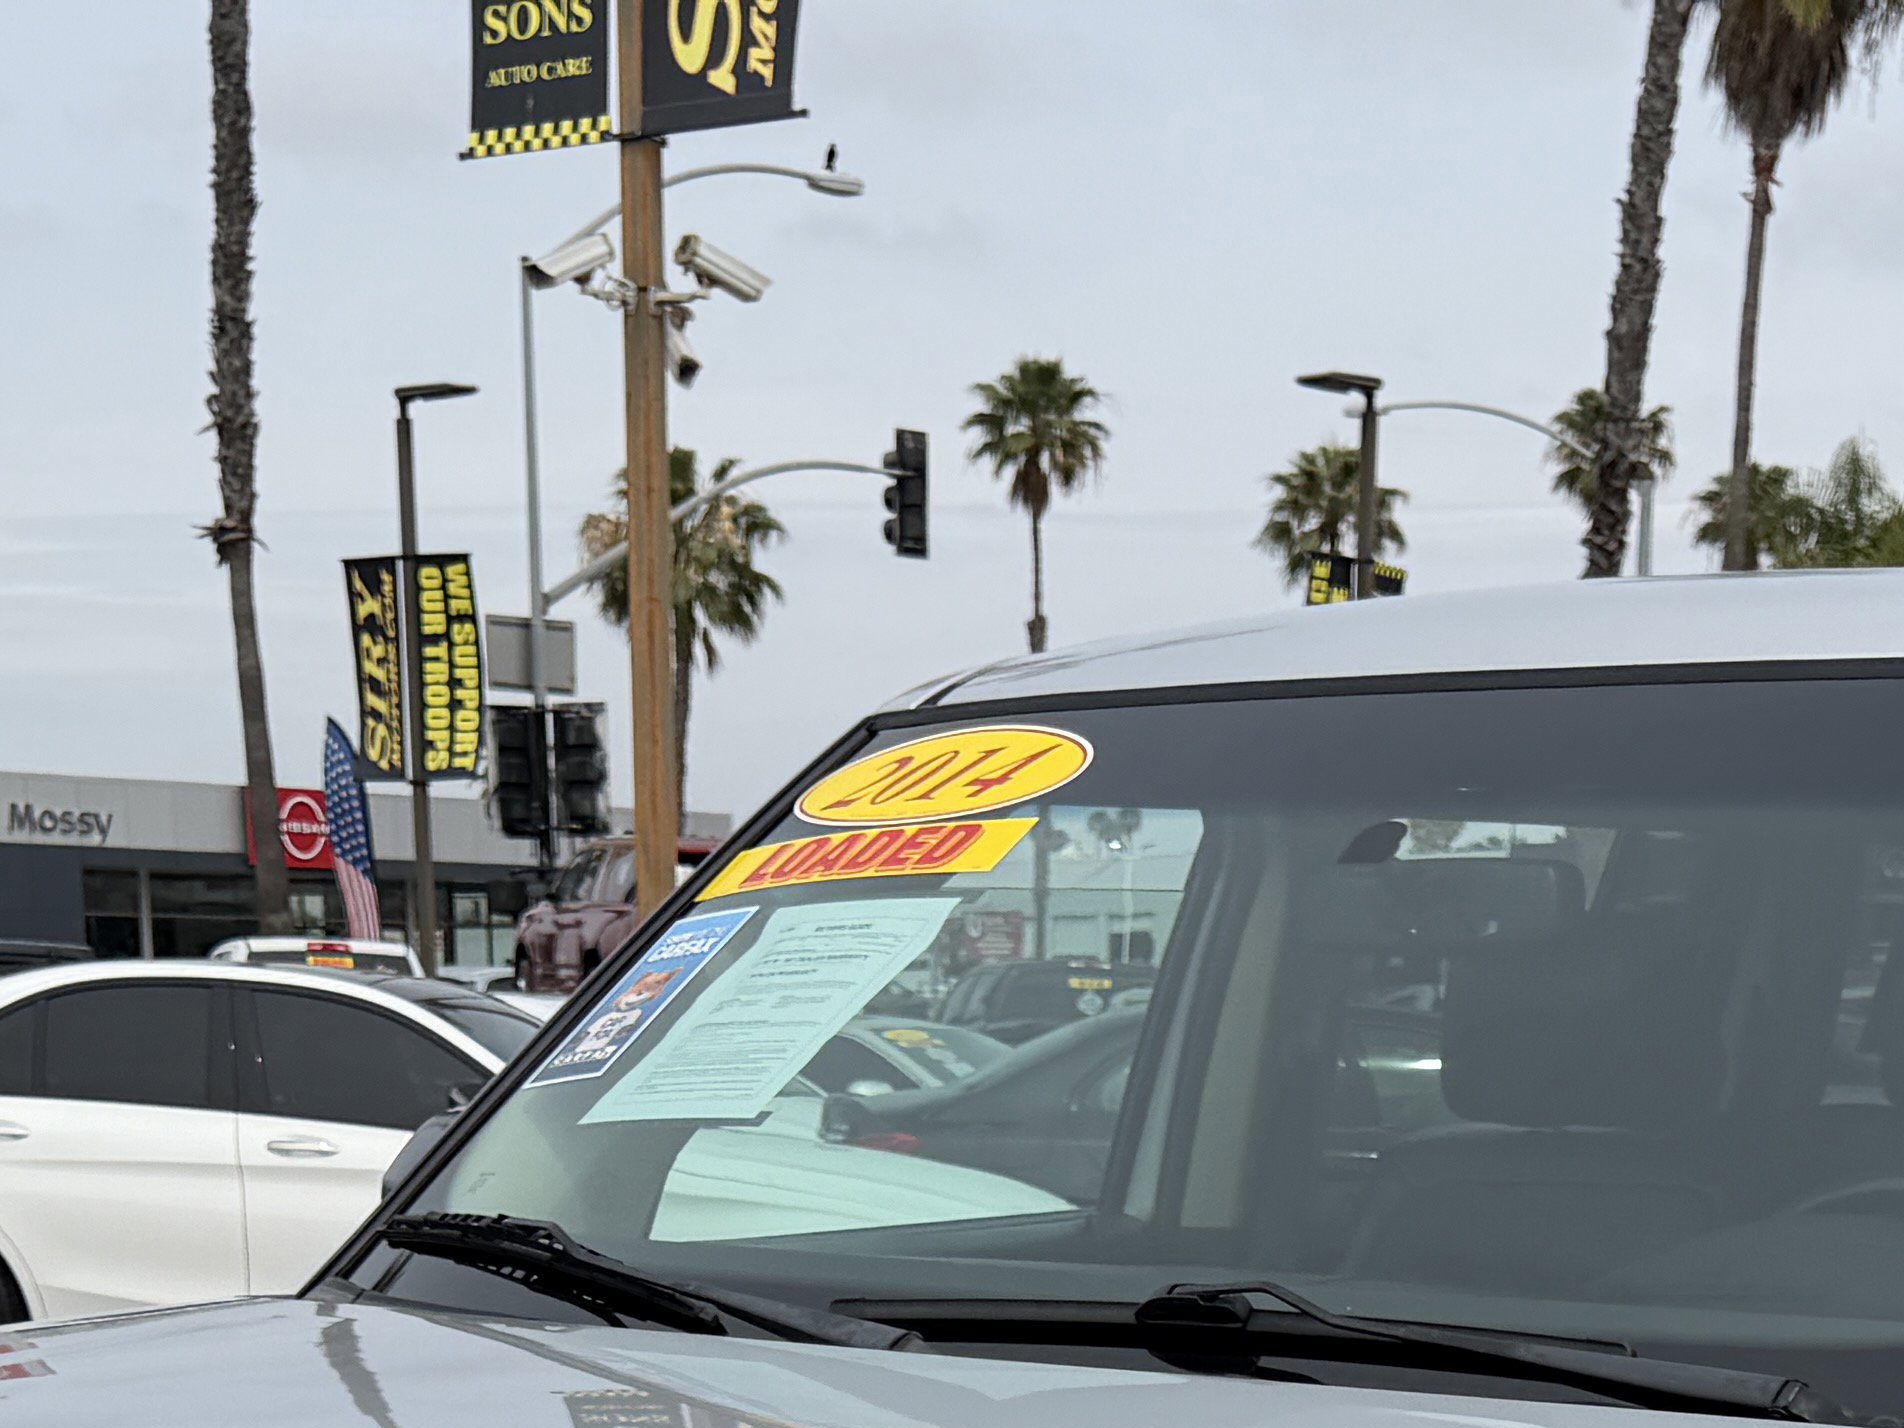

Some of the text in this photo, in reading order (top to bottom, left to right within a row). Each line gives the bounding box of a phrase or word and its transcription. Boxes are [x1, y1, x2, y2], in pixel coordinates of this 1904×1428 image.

[483, 0, 593, 46] SONS
[486, 56, 593, 88] AUTO CARE
[417, 566, 451, 773] OUR TROOPS
[445, 562, 480, 772] WE SUPPORT
[821, 743, 1062, 811] 2014
[7, 802, 113, 846] Mossy
[738, 823, 986, 889] LOADED
